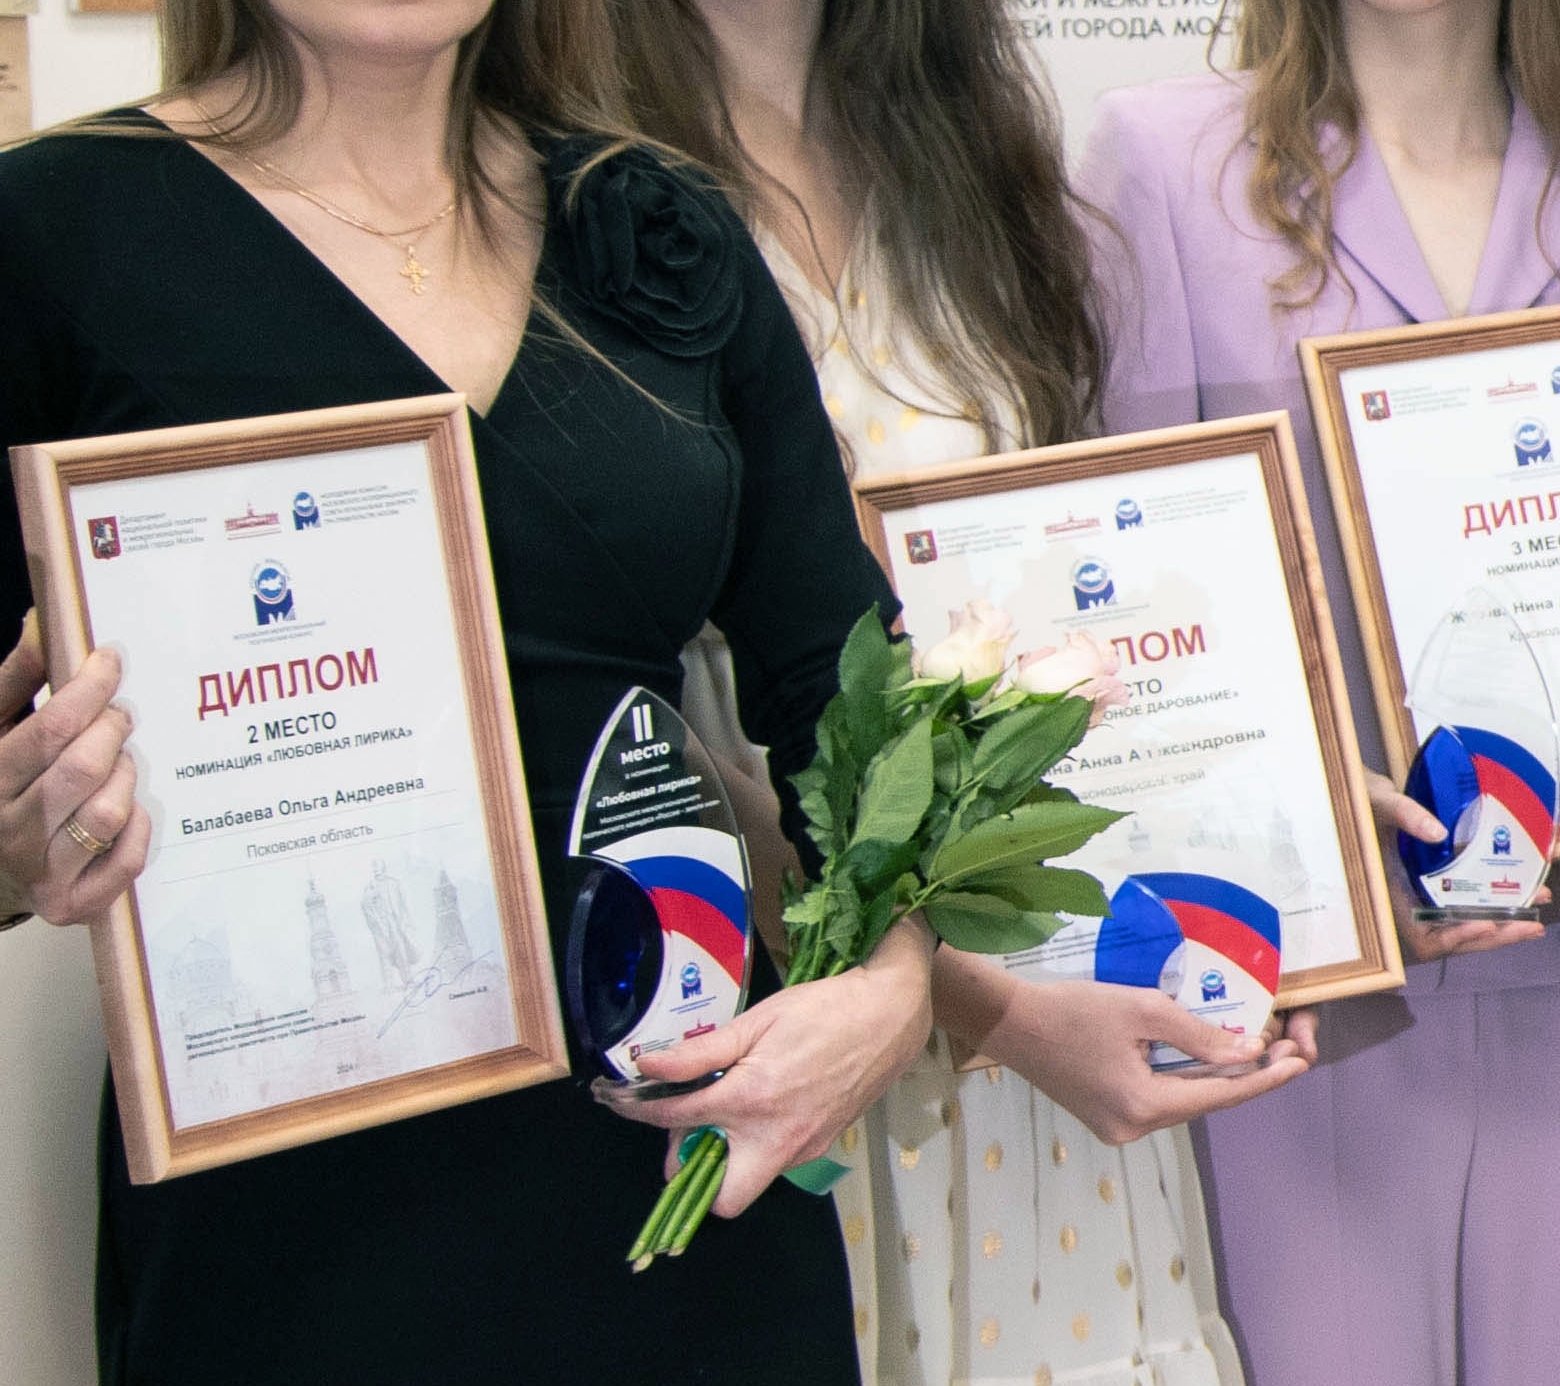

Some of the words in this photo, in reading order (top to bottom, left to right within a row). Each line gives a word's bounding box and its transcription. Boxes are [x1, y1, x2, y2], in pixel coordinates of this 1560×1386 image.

[1061, 16, 1166, 40] ГОРОДА
[1511, 540, 1523, 556] 3
[1512, 599, 1554, 619] Нина
[197, 647, 379, 720] ДИПЛОМ
[246, 724, 260, 744] 2
[263, 710, 337, 741] МЕСТО
[632, 703, 654, 743] II
[175, 752, 263, 780] НОМИНАЦИЯ
[266, 736, 351, 763] «ЛЮБОВНАЯ
[354, 726, 413, 748] ЛИРИКА»
[620, 741, 671, 765] место
[1079, 754, 1127, 776] Анна
[181, 806, 274, 836] Балабаева
[278, 796, 329, 816] Ольга
[334, 777, 425, 806] Андреевна
[596, 786, 656, 809] «Любовная
[657, 775, 702, 794] лирика»
[246, 835, 318, 859] Псковская
[319, 825, 374, 845] область
